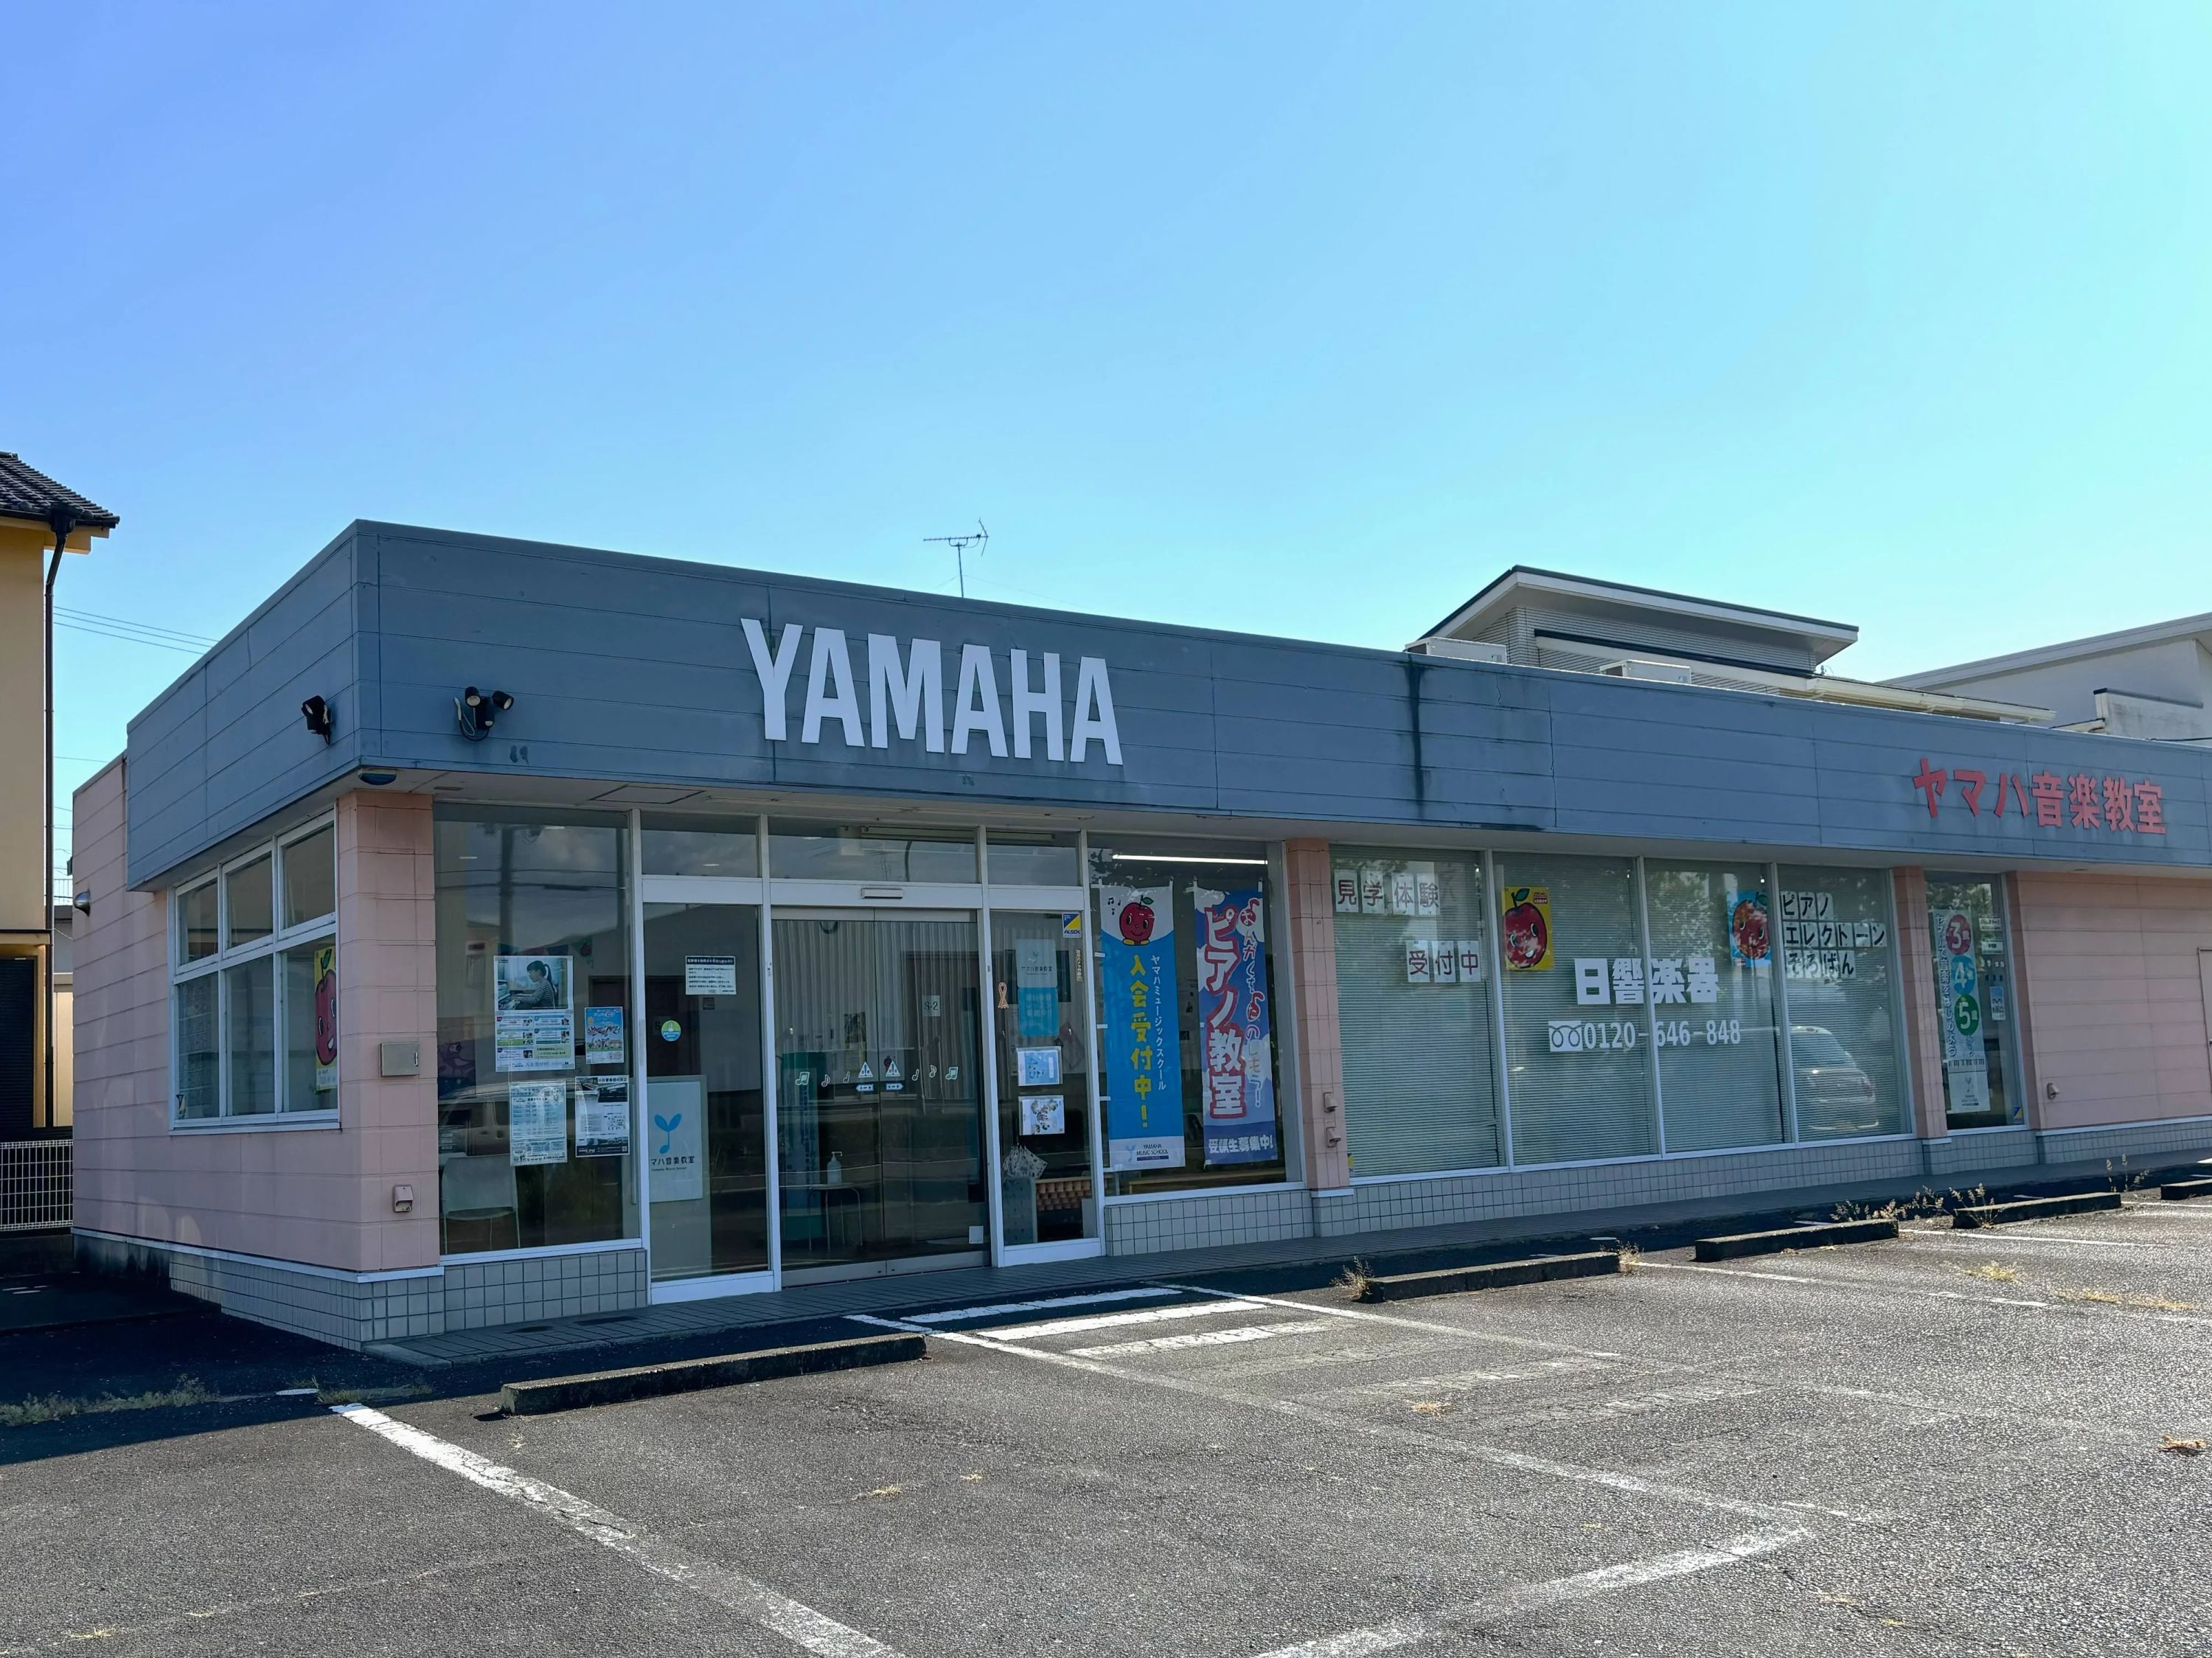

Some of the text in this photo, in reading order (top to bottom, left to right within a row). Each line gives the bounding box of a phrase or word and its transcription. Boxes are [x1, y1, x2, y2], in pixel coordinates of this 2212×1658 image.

[740, 619, 1123, 765] YAMAHA
[1913, 758, 2166, 835] ヤマハ音楽教室
[1782, 894, 1829, 917] ピアノ
[1786, 924, 1885, 947] エレクトーン
[1409, 950, 1478, 975] 受付中
[1574, 957, 1721, 1005] 日響楽器
[1788, 952, 1854, 975] そろばん
[1151, 955, 1166, 1090] ヤマハミュージックスクール
[1204, 908, 1245, 1118] ピアノ教室
[1130, 955, 1153, 1127] 入会受付中!
[1208, 1134, 1274, 1155] 受講生募集中!
